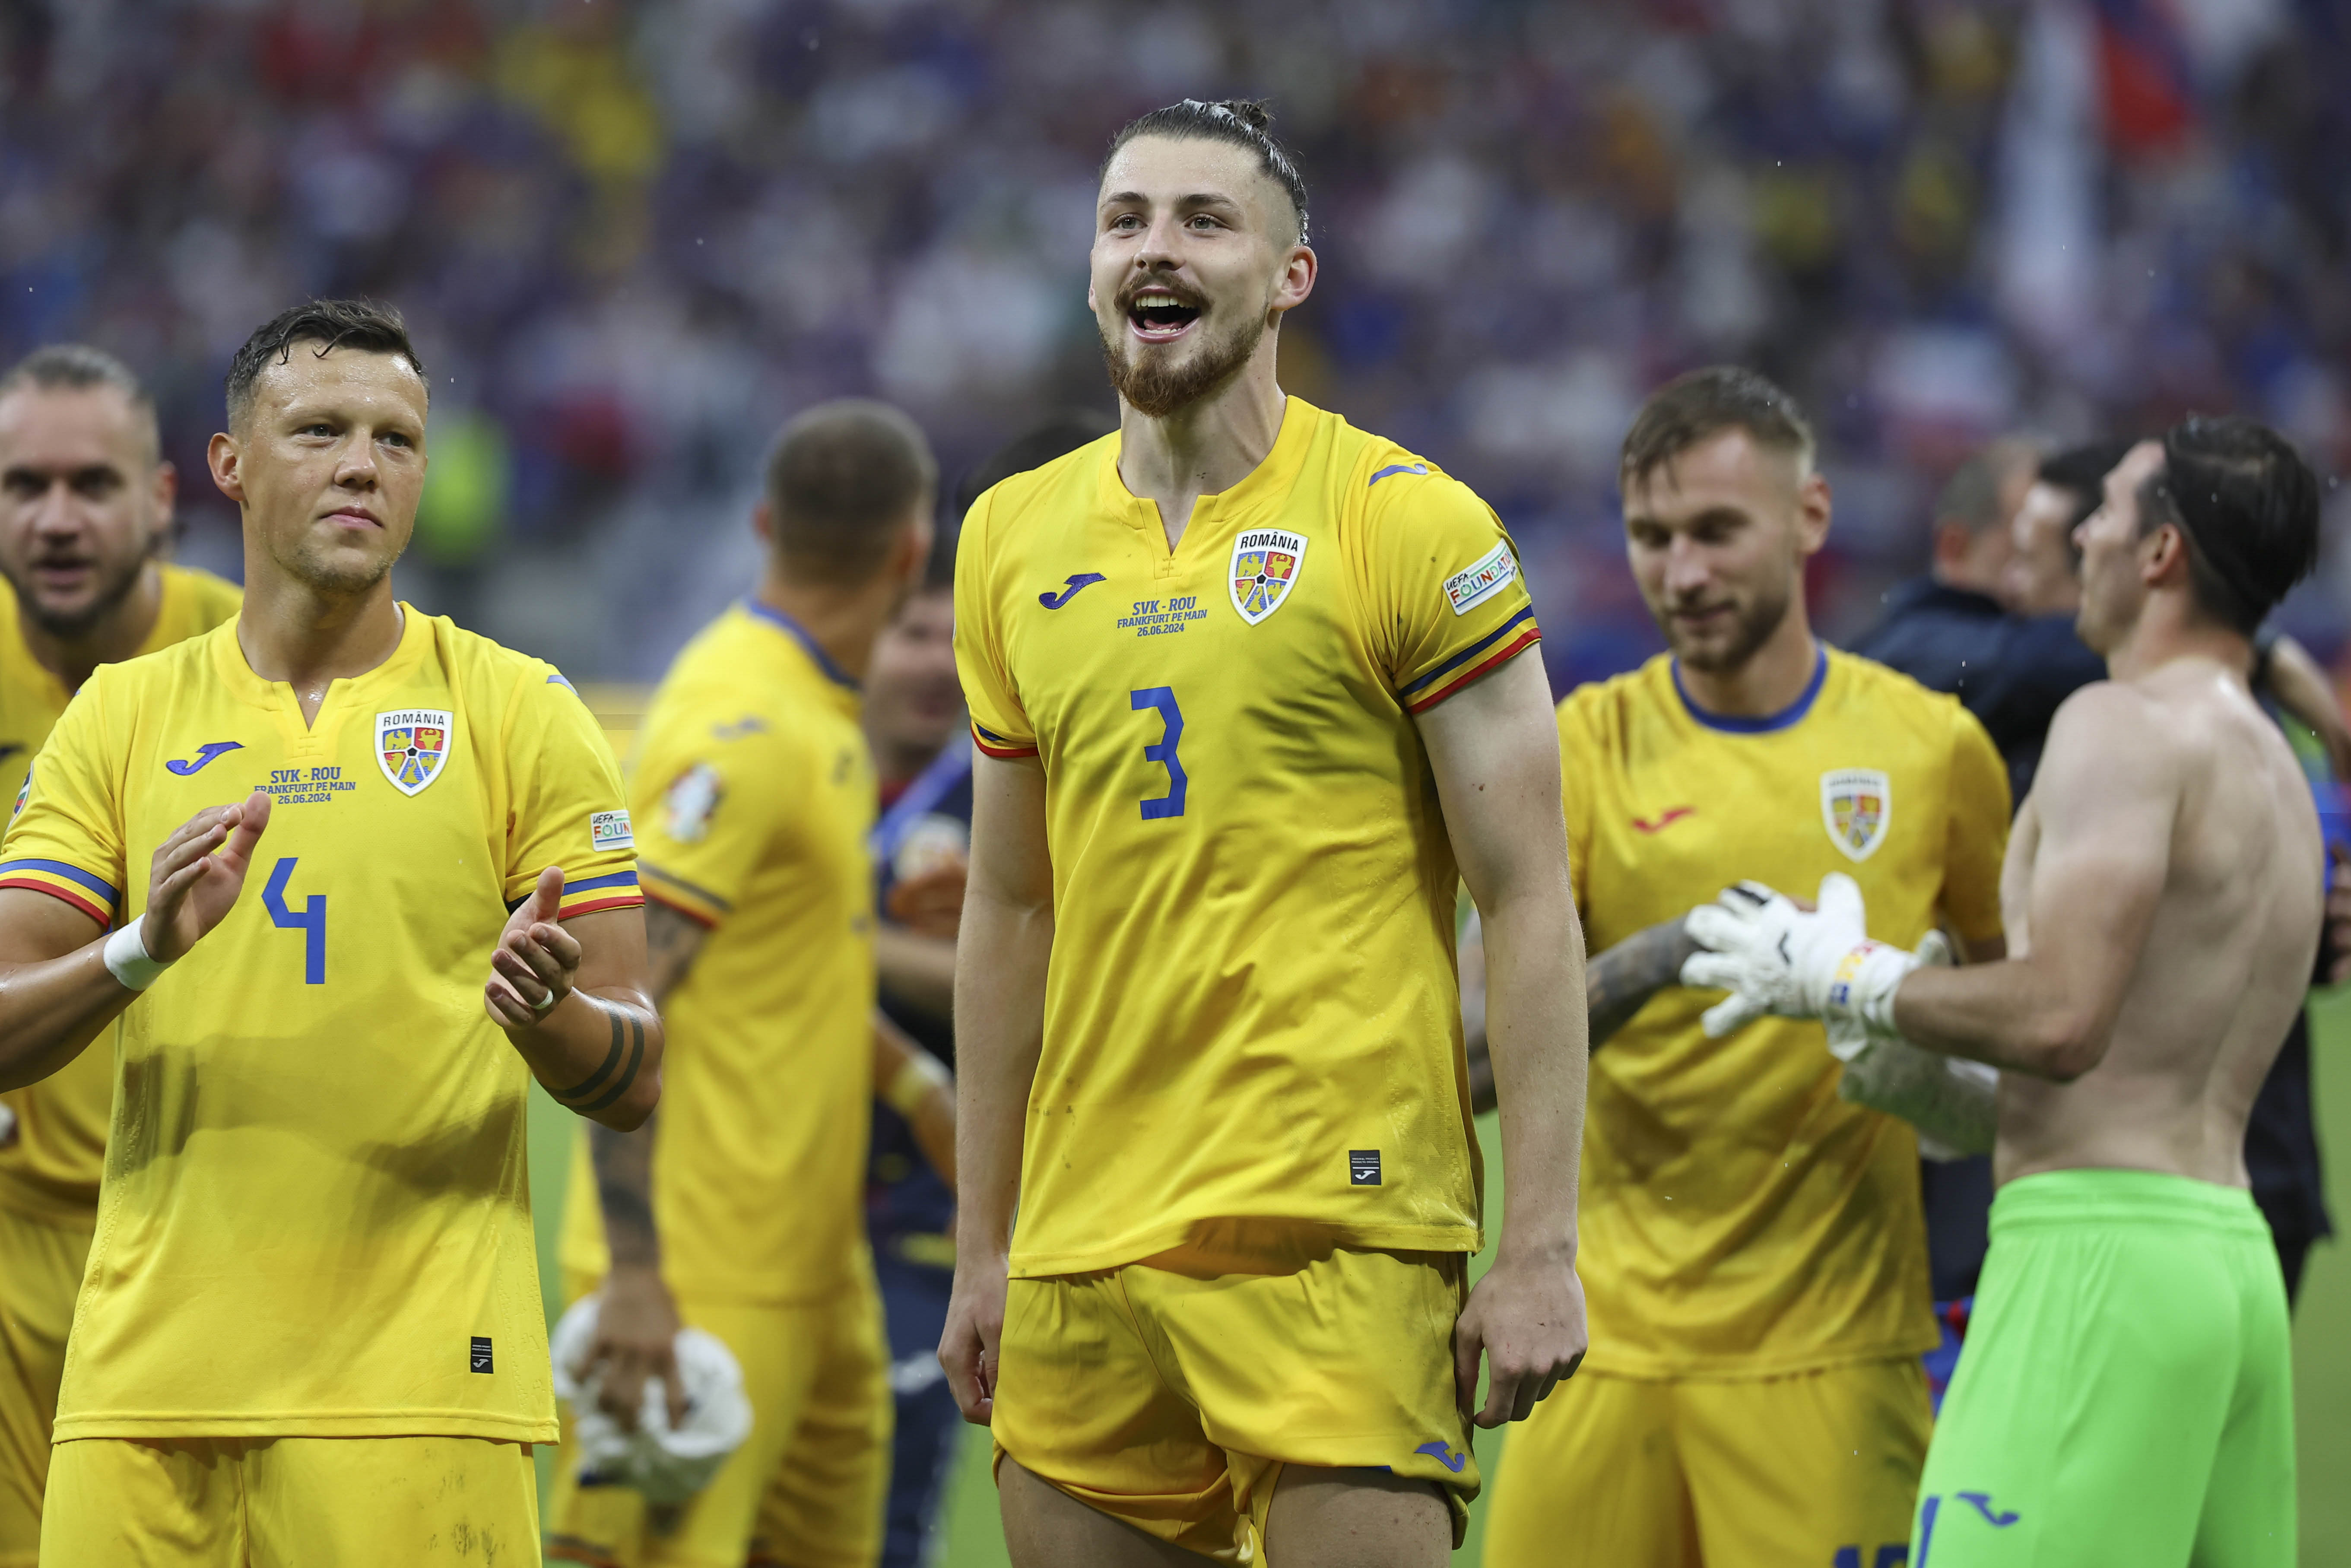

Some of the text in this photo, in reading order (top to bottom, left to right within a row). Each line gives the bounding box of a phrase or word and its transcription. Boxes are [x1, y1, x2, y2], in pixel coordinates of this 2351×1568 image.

[1241, 532, 1298, 552] ROMÂNIA
[1447, 572, 1469, 590] UEFA
[1132, 600, 1160, 616] SVK
[1168, 596, 1196, 612] ROU
[1117, 609, 1208, 628] FRANKFURT PE MAIN
[1137, 623, 1184, 637] 26.06.2024
[384, 711, 444, 727] ROMÂNIA
[1130, 686, 1188, 820] 3
[270, 769, 301, 784] SVK
[311, 767, 341, 781] ROU
[254, 781, 356, 794] FRANKFURT PE MAIN
[278, 793, 331, 804] 26.06.2024
[593, 814, 614, 824] UEFA
[261, 857, 326, 984] 4
